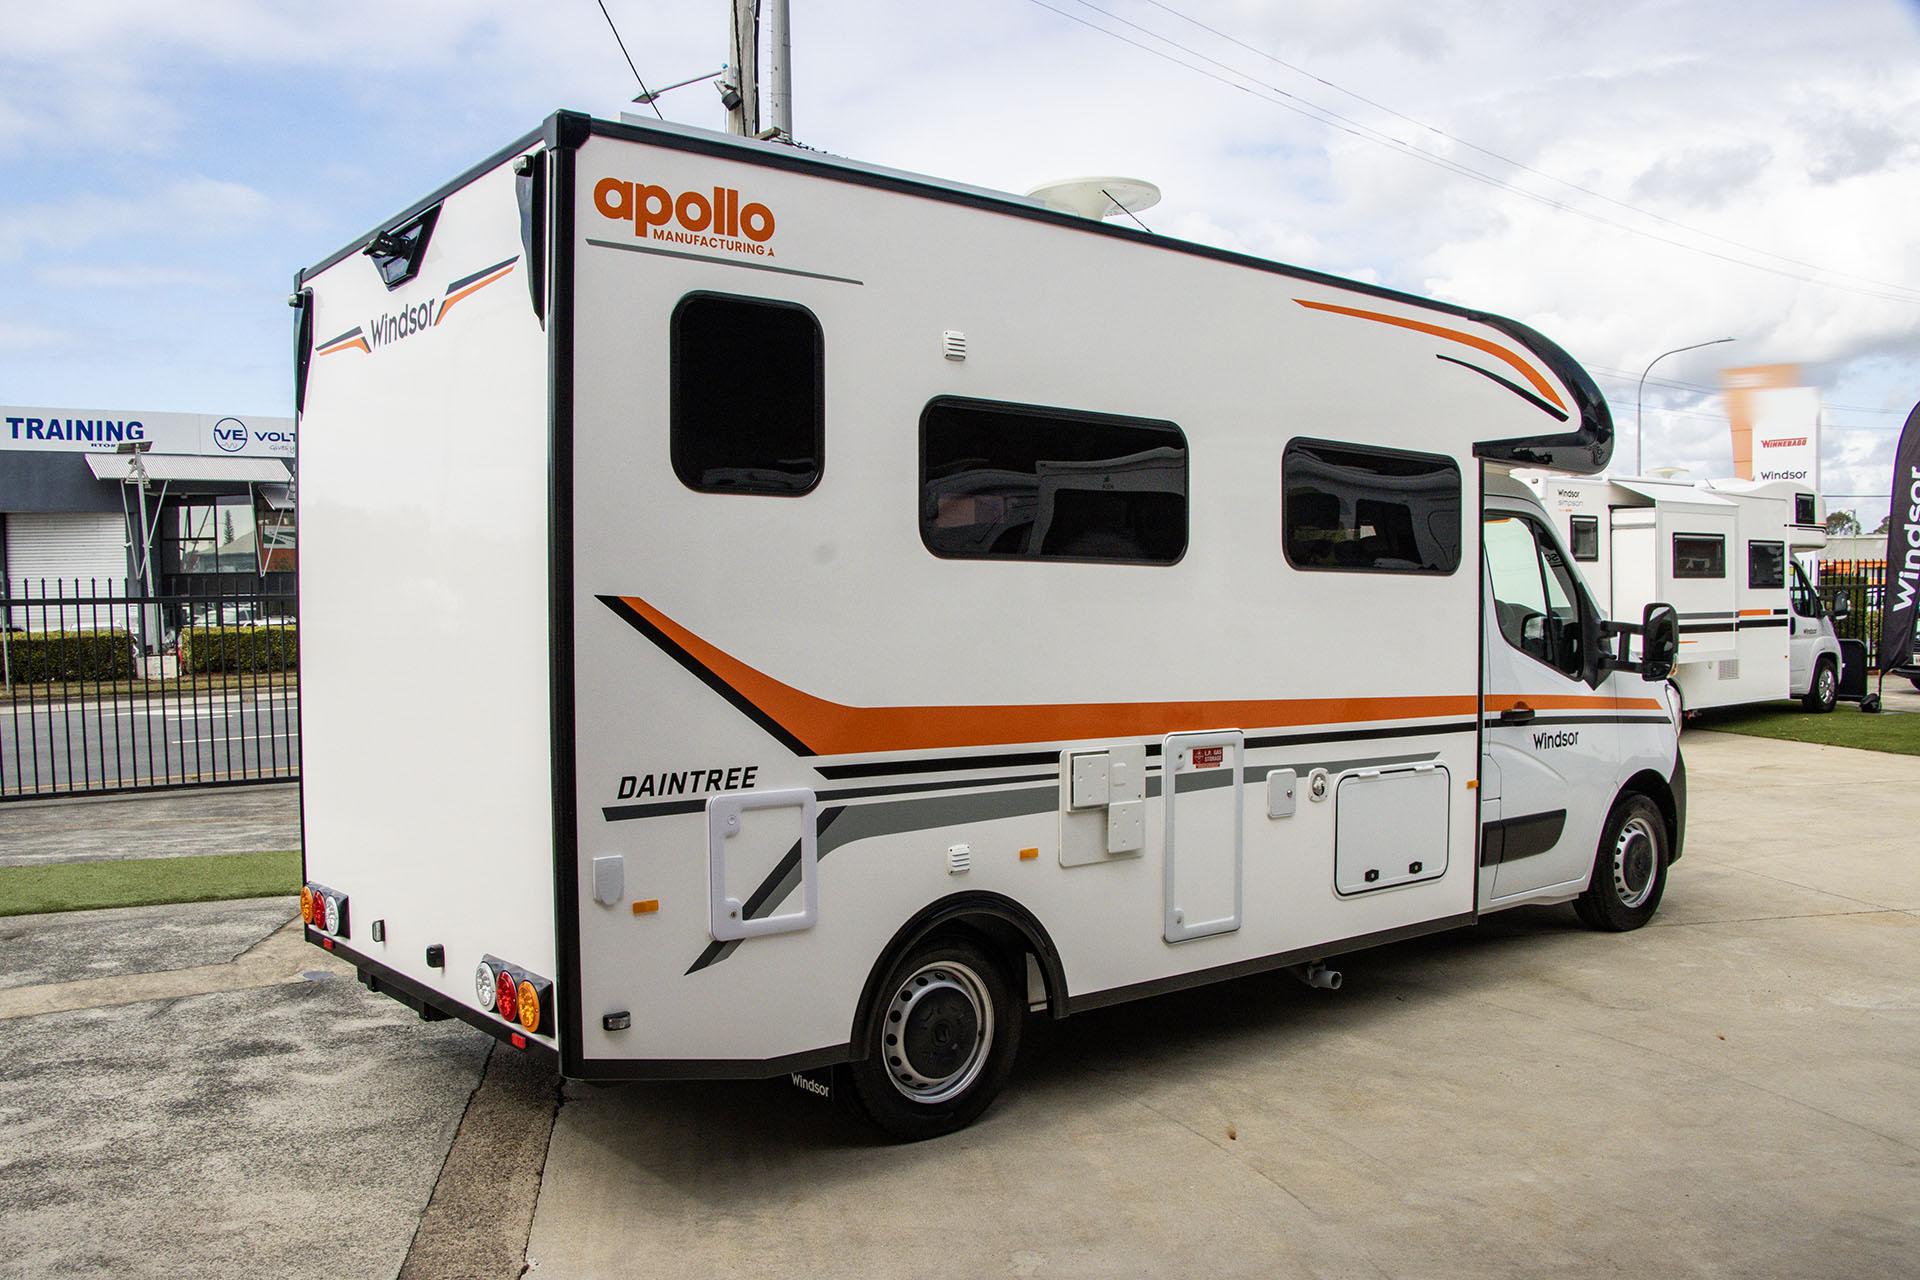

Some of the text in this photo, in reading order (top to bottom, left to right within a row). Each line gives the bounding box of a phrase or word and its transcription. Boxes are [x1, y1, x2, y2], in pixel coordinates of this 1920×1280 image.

[593, 177, 775, 242] apollo
[653, 229, 765, 256] MANUFACTURING
[371, 298, 435, 349] Windsor
[5, 417, 144, 441] TRAINING
[1761, 470, 1807, 480] Windsor
[1557, 489, 1580, 498] Windsor
[1533, 731, 1579, 750] Windsor
[617, 766, 758, 799] DAINTREE
[791, 1071, 829, 1097] Windsor
